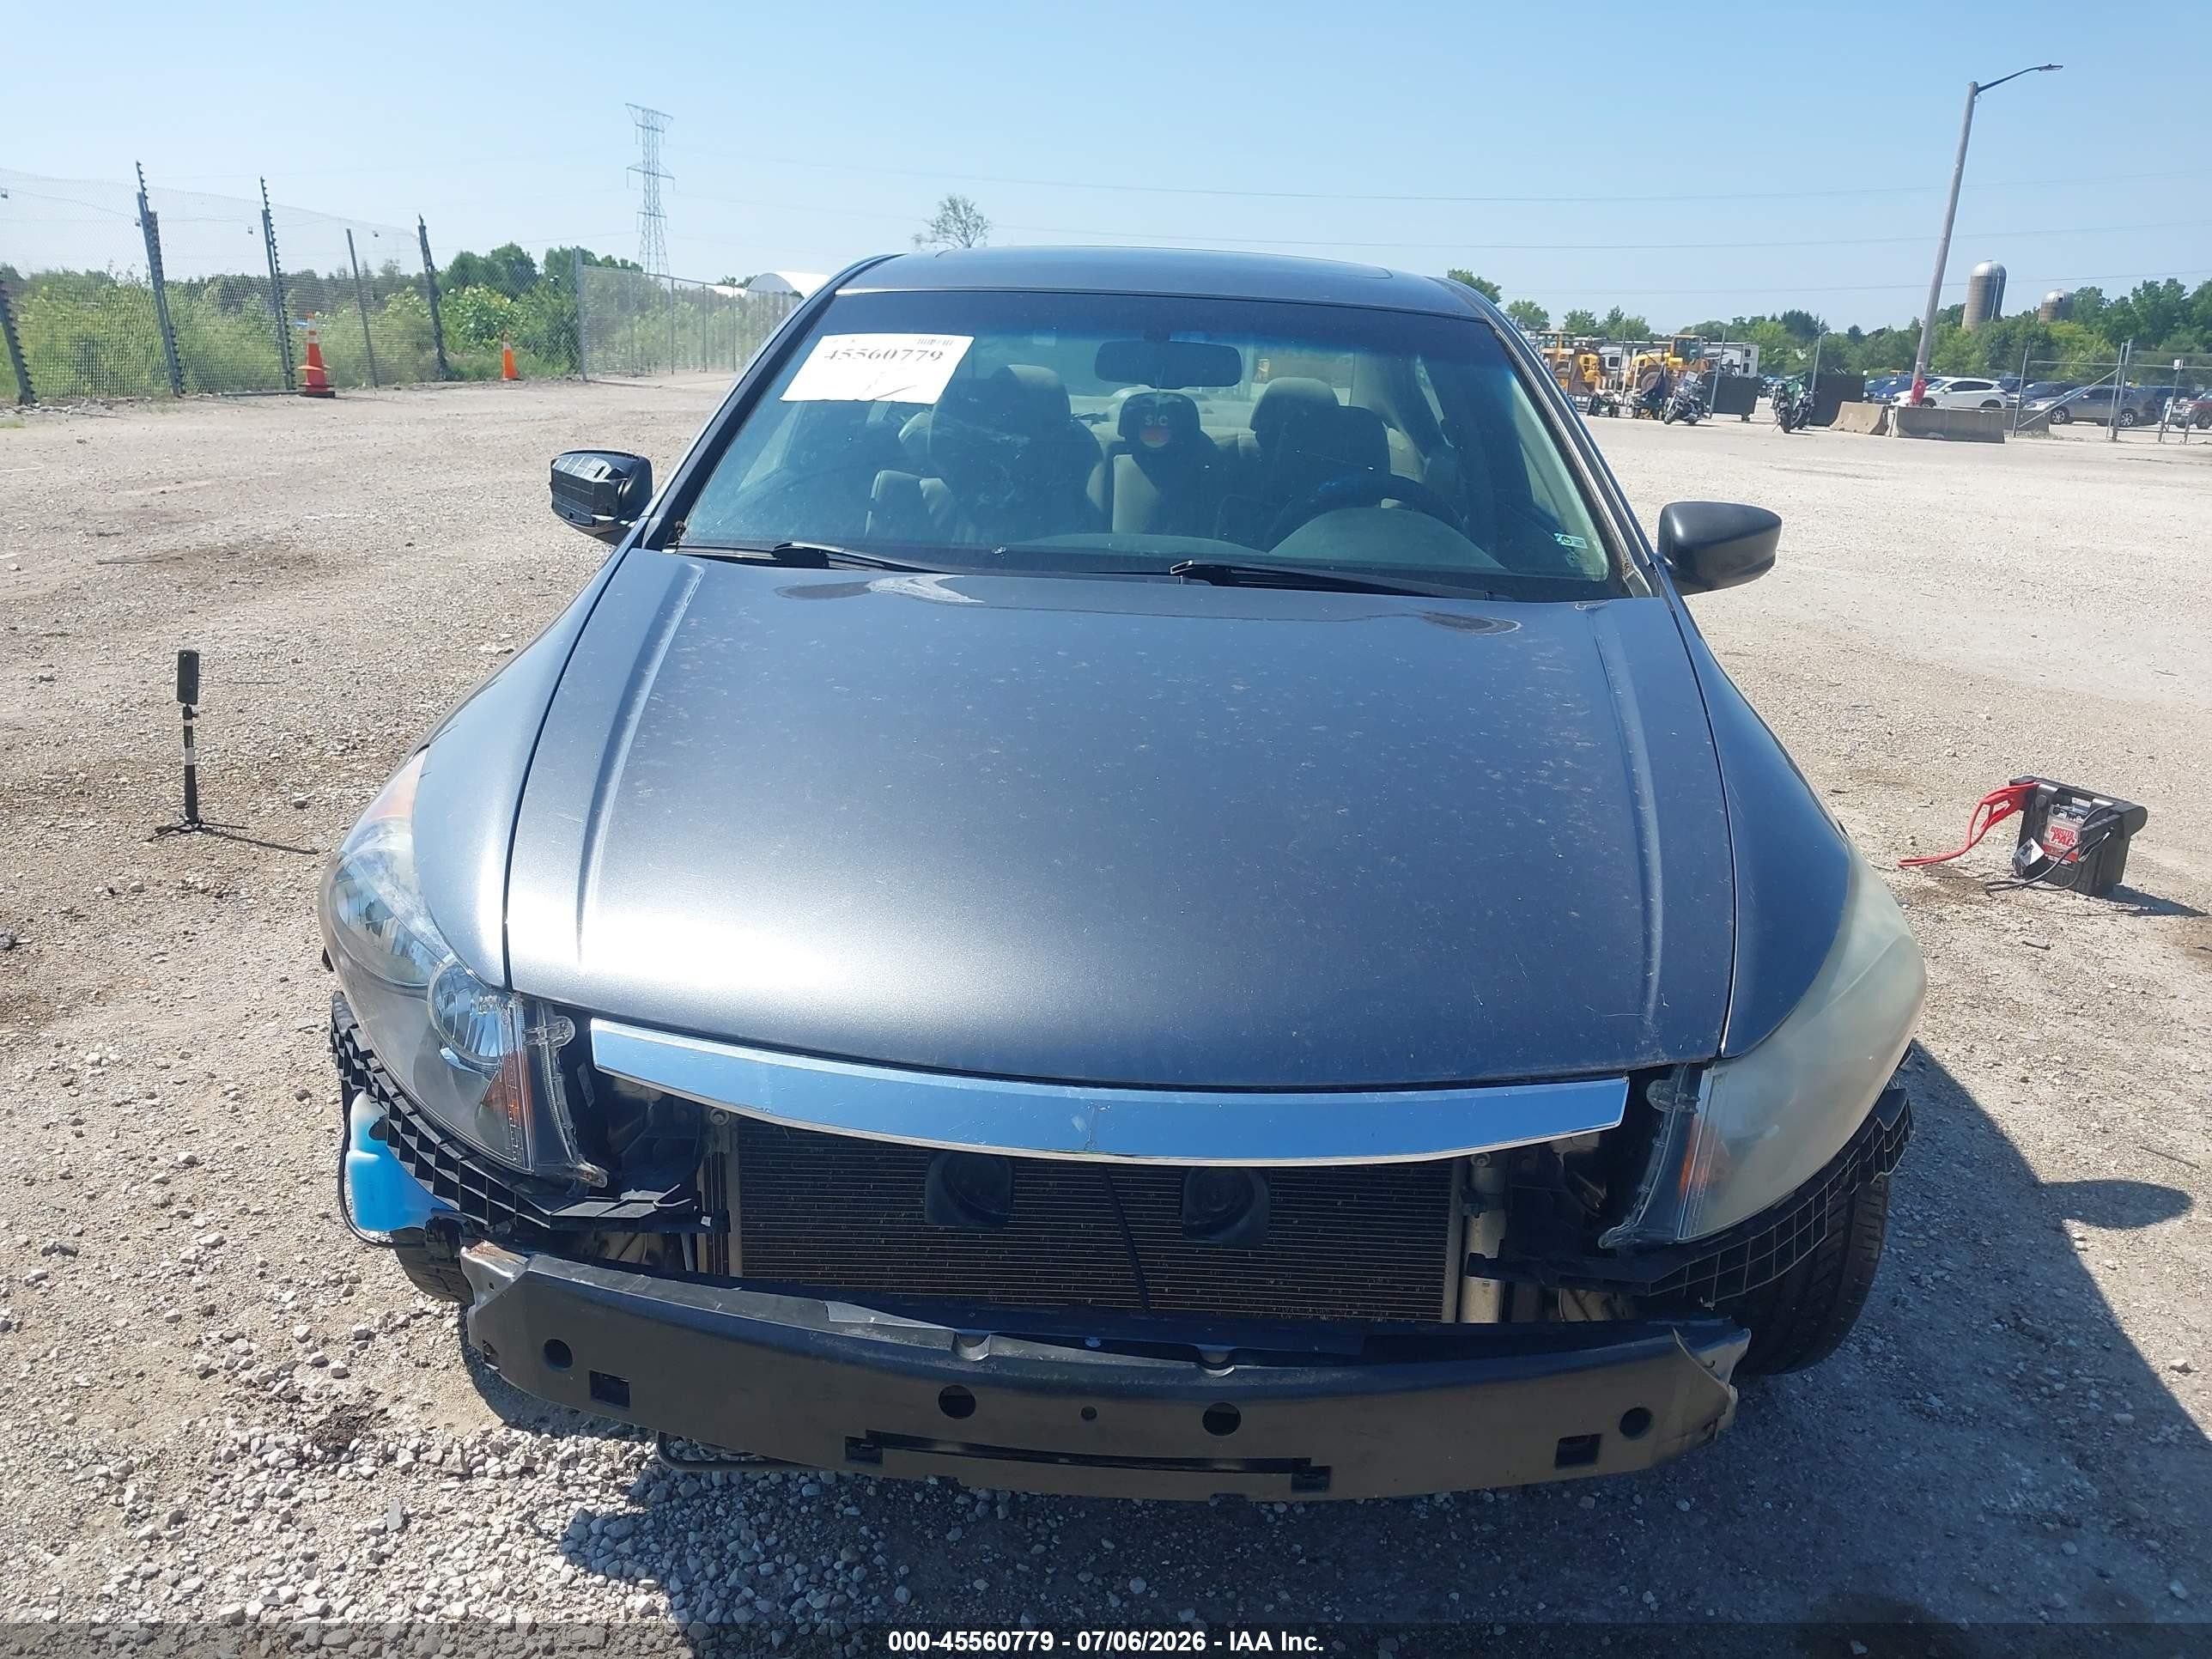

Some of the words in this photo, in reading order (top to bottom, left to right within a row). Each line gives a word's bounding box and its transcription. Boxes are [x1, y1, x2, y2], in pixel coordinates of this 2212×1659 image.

[824, 349, 944, 362] 45560779
[2050, 825, 2075, 838] BOOSTER
[2050, 832, 2076, 848] PAC
